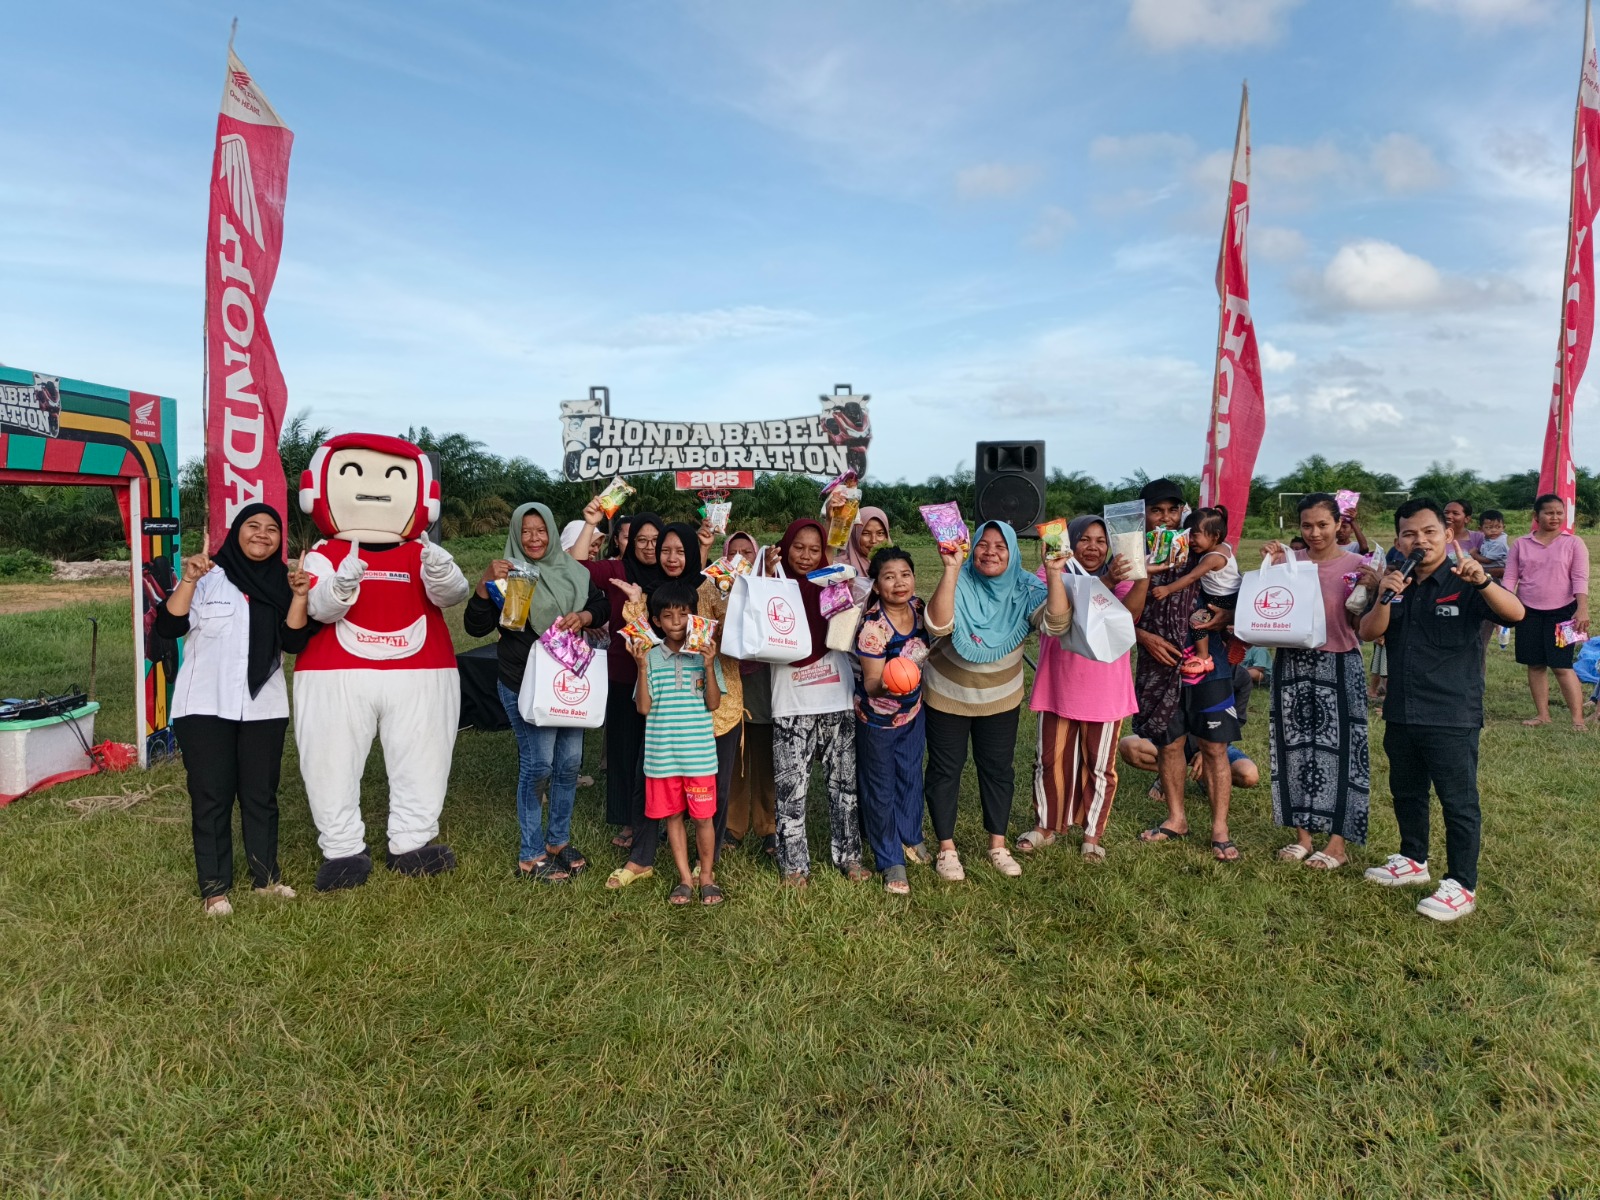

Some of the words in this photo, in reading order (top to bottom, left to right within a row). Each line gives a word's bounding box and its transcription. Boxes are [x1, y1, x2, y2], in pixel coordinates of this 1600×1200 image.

[229, 89, 241, 102] One
[219, 213, 264, 529] HONDA
[600, 417, 713, 447] HONDA
[721, 415, 829, 446] BABEL
[578, 445, 849, 480] COLLABORATION
[690, 471, 740, 487] 2025
[1251, 621, 1271, 629] Honda
[1272, 621, 1291, 629] Babel
[768, 635, 784, 644] Honda
[784, 637, 798, 646] Babel
[549, 706, 570, 715] Honda
[570, 708, 588, 717] Babel
